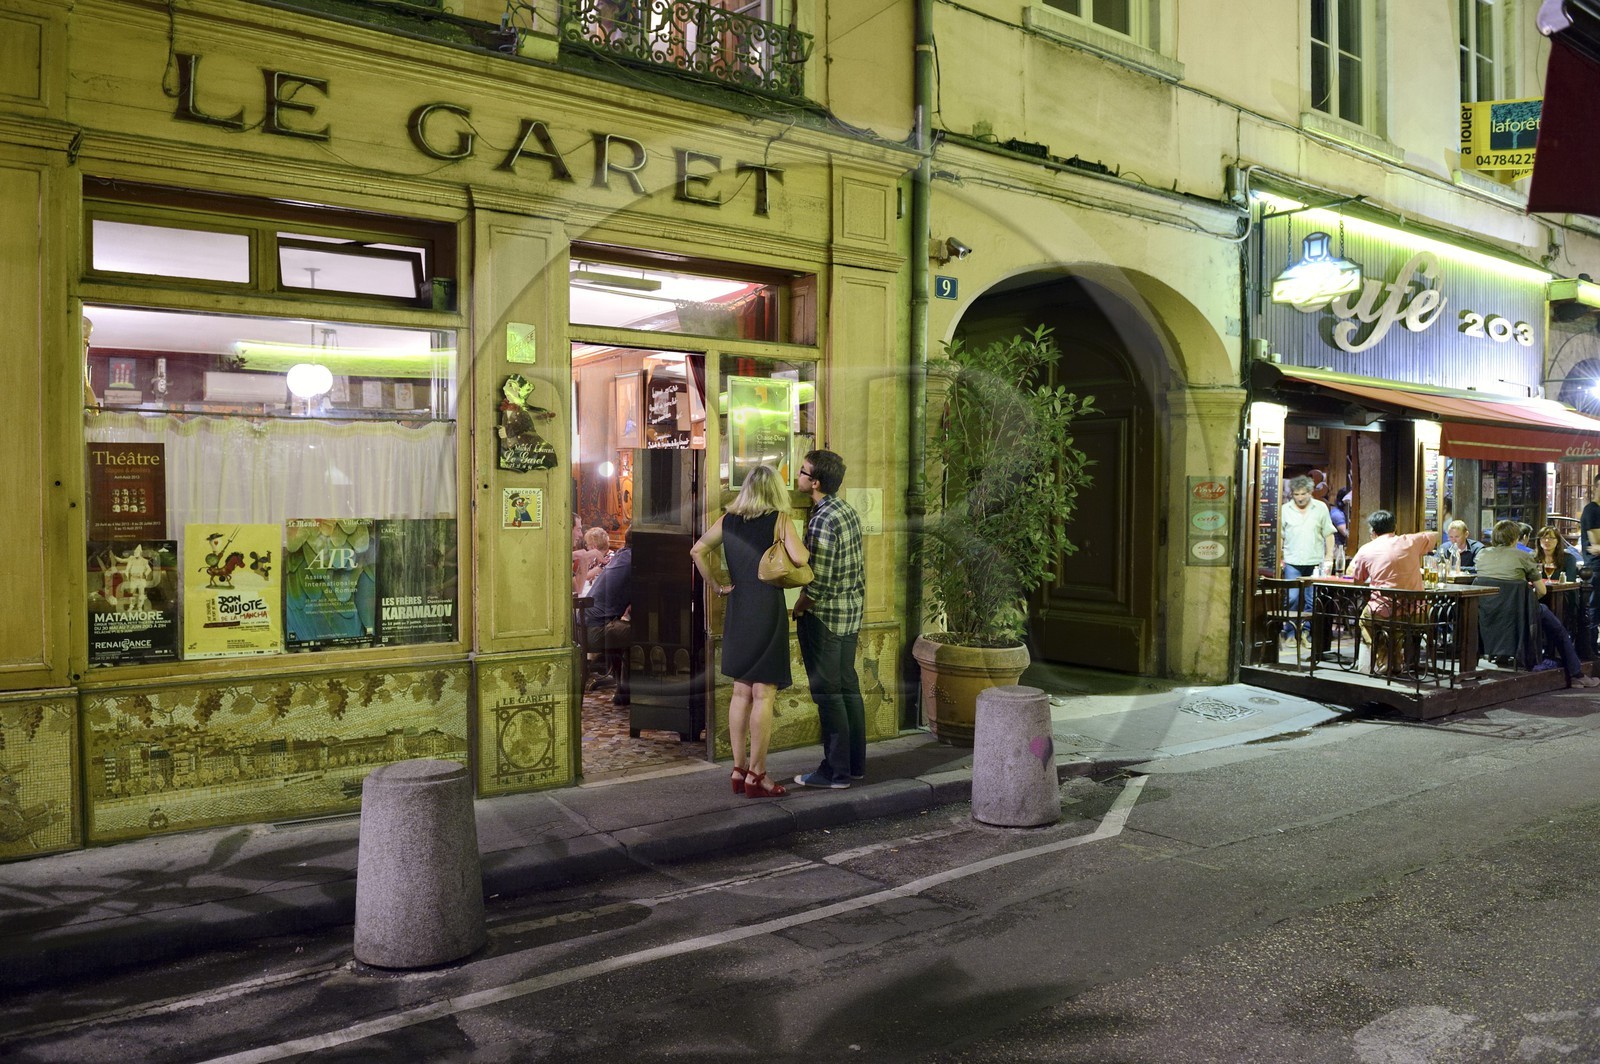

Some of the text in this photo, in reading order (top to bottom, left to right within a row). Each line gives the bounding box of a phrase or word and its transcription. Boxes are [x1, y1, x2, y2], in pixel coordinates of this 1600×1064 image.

[1460, 106, 1472, 143] louer
[1492, 117, 1541, 133] laforêt
[172, 50, 787, 219] LE GARET
[942, 280, 951, 296] 9
[1463, 311, 1535, 347] 203
[504, 448, 516, 462] Le
[520, 452, 546, 464] Garet
[1566, 440, 1592, 456] café
[92, 450, 160, 466] Théâtre
[304, 548, 358, 569] AIR
[218, 594, 241, 604] DON
[382, 596, 422, 606] LES FRÈRES
[94, 610, 164, 622] MATAMORE
[240, 611, 268, 619] MANCHA
[382, 604, 452, 620] KARAMAZOV
[503, 694, 550, 705] LE GARET
[504, 772, 547, 784] LYON
